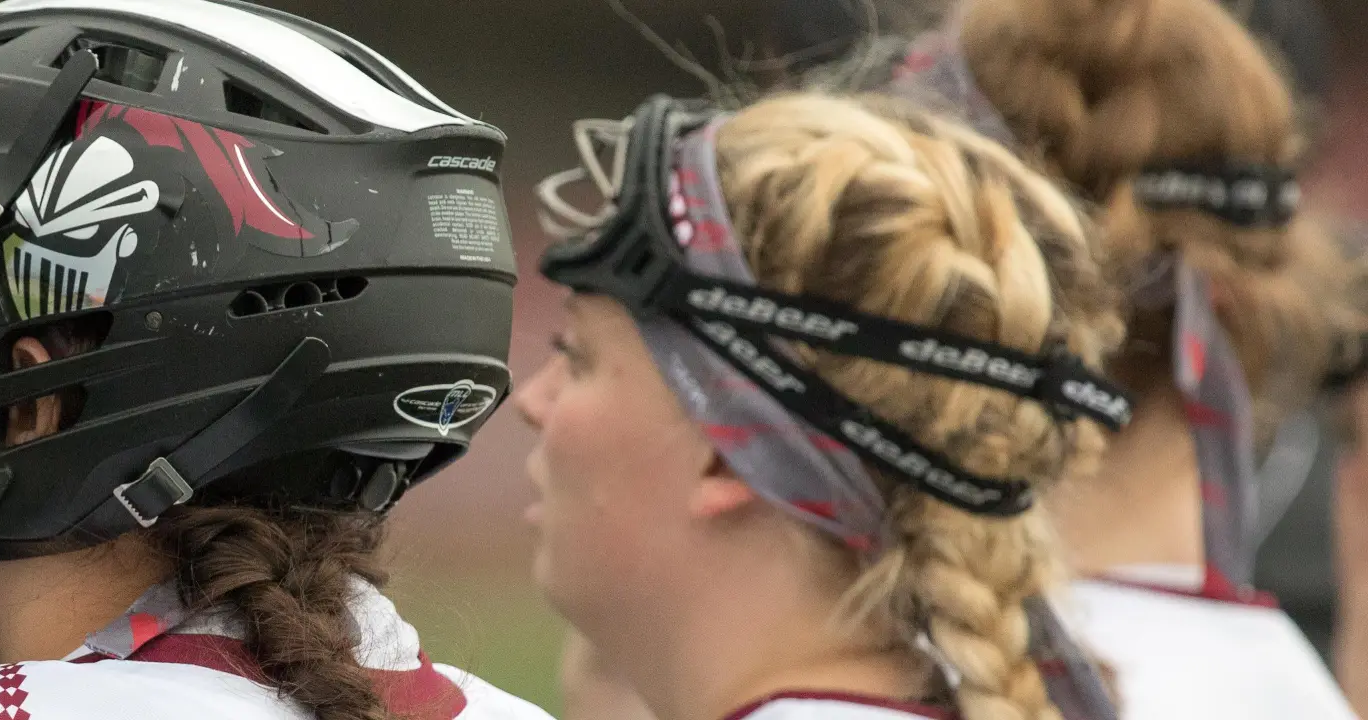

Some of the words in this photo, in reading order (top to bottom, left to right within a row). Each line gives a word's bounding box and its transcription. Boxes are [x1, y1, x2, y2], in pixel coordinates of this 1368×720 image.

[427, 156, 497, 172] cascade
[688, 287, 859, 340] deBeer
[840, 419, 1002, 505] deBeer
